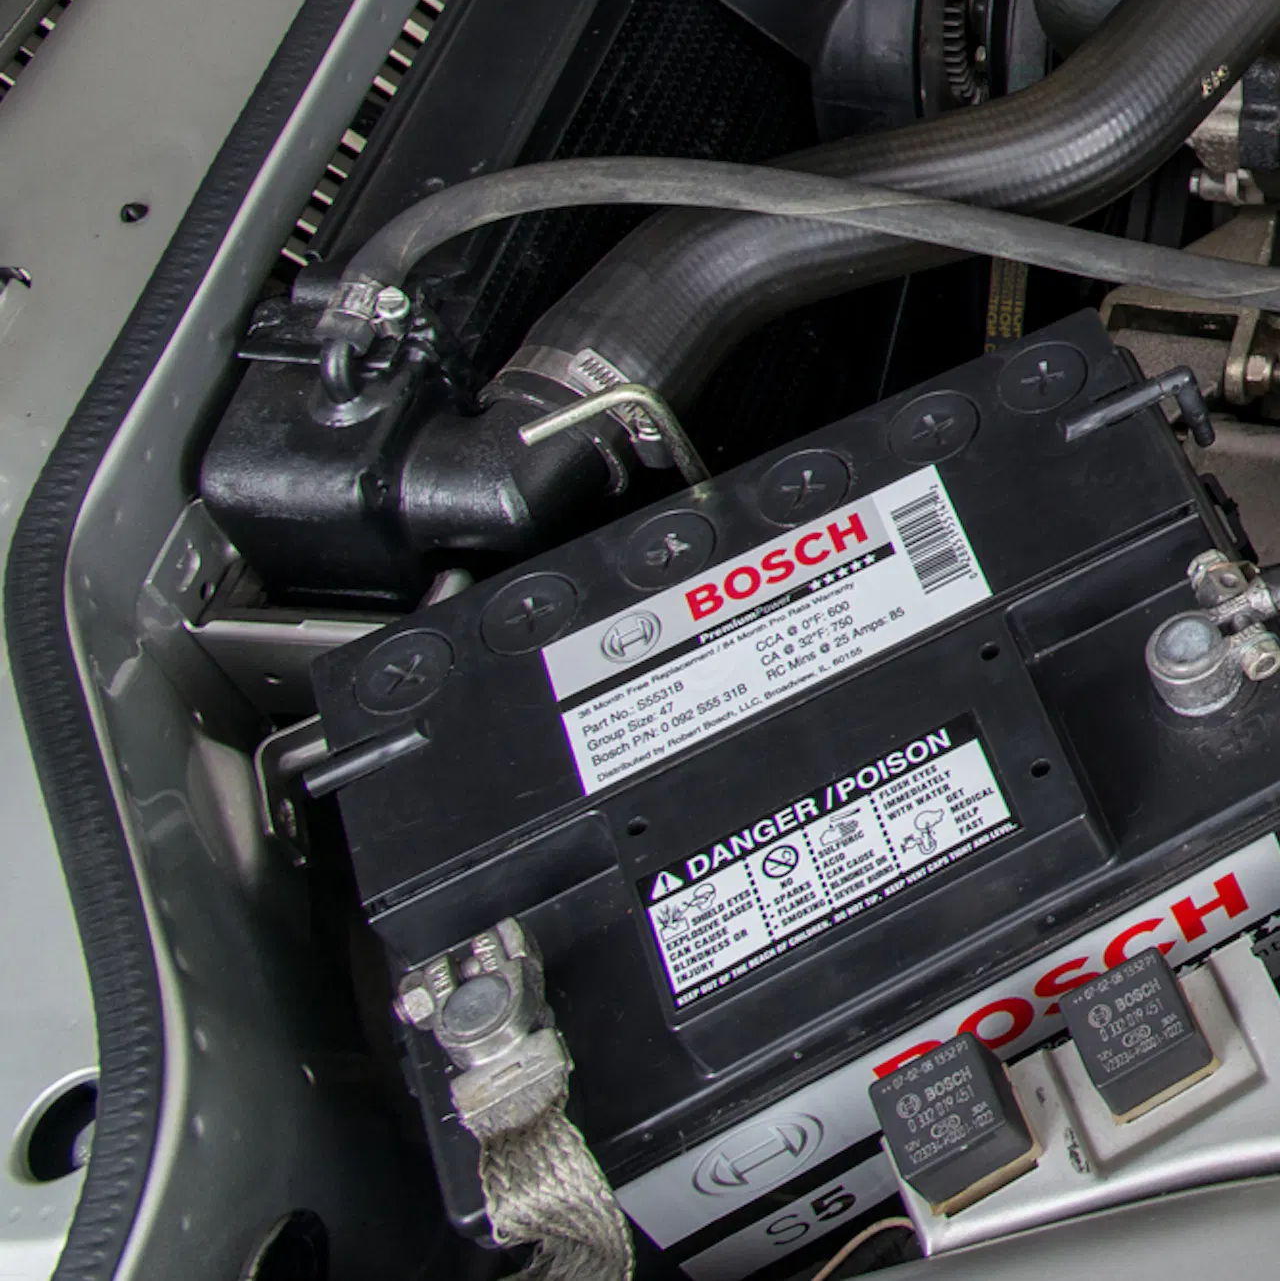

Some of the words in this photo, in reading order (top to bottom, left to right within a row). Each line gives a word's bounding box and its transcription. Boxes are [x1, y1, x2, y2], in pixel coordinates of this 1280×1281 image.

[685, 511, 867, 622] BOSCH
[698, 591, 792, 645] PremiumPower
[754, 630, 784, 653] CCA
[786, 622, 799, 637] @
[827, 598, 850, 618] 600
[591, 690, 625, 712] Month
[626, 679, 648, 696] Free
[650, 647, 716, 686] Replacement
[736, 621, 768, 643] Month
[769, 612, 786, 627] Pro
[787, 601, 811, 618] Rata
[812, 579, 856, 608] Warranty
[760, 649, 781, 667] CA
[782, 642, 795, 657] @
[830, 614, 854, 634] 750
[766, 663, 787, 681] RC
[788, 648, 817, 671] Mins
[818, 641, 831, 656] @
[833, 632, 850, 649] 25
[851, 613, 889, 642] Amps:
[888, 605, 905, 622] 85
[581, 716, 606, 736] Part
[608, 702, 635, 724] No.:
[636, 679, 684, 711] S5531B
[586, 724, 626, 754] Group
[626, 709, 656, 732] Size:
[658, 700, 675, 717] 47
[591, 739, 629, 767] Bosch
[631, 725, 659, 747] P/N:
[659, 720, 670, 733] 0
[671, 708, 695, 728] 092
[696, 695, 721, 715] S55
[722, 682, 747, 703] 31B
[596, 749, 650, 782] Distributed
[651, 742, 666, 757] by
[667, 724, 701, 748] Robert
[701, 707, 737, 732] Bosch,
[738, 694, 763, 715] LLC,
[832, 645, 862, 666] 60155
[878, 776, 910, 800] FLUSH
[912, 762, 937, 782] EYES
[882, 768, 952, 810] IMMEDIATELY
[946, 787, 965, 804] GET
[950, 784, 993, 815] MEDICAL
[887, 800, 914, 821] WITH
[915, 782, 950, 806] WATER
[954, 804, 980, 825] HELP
[685, 795, 819, 881] DANGER
[817, 828, 864, 859] SULFURIC
[958, 815, 984, 836] FAST
[821, 850, 846, 870] ACID
[825, 863, 846, 880] CAN
[847, 848, 875, 869] CAUSE
[829, 861, 872, 890] BLINDNESS
[772, 878, 812, 906] SPARKS
[779, 875, 793, 890] NO
[833, 878, 864, 901] SEVERE
[866, 862, 894, 883] BURNS
[690, 901, 724, 926] SHIELD
[726, 887, 751, 907] EYES
[777, 889, 816, 917] FLAMES
[781, 896, 826, 928] SMOKING
[665, 916, 720, 951] EXPLOSIVE
[721, 899, 753, 922] GASES
[669, 944, 691, 962] CAN
[692, 925, 729, 950] CAUSE
[672, 936, 730, 973] BLINDNESS
[731, 927, 748, 942] OR
[675, 957, 715, 984] INJURY
[1114, 976, 1161, 1013] BOSCH
[924, 1064, 973, 1102] BOSCH
[766, 1186, 857, 1247] S5
